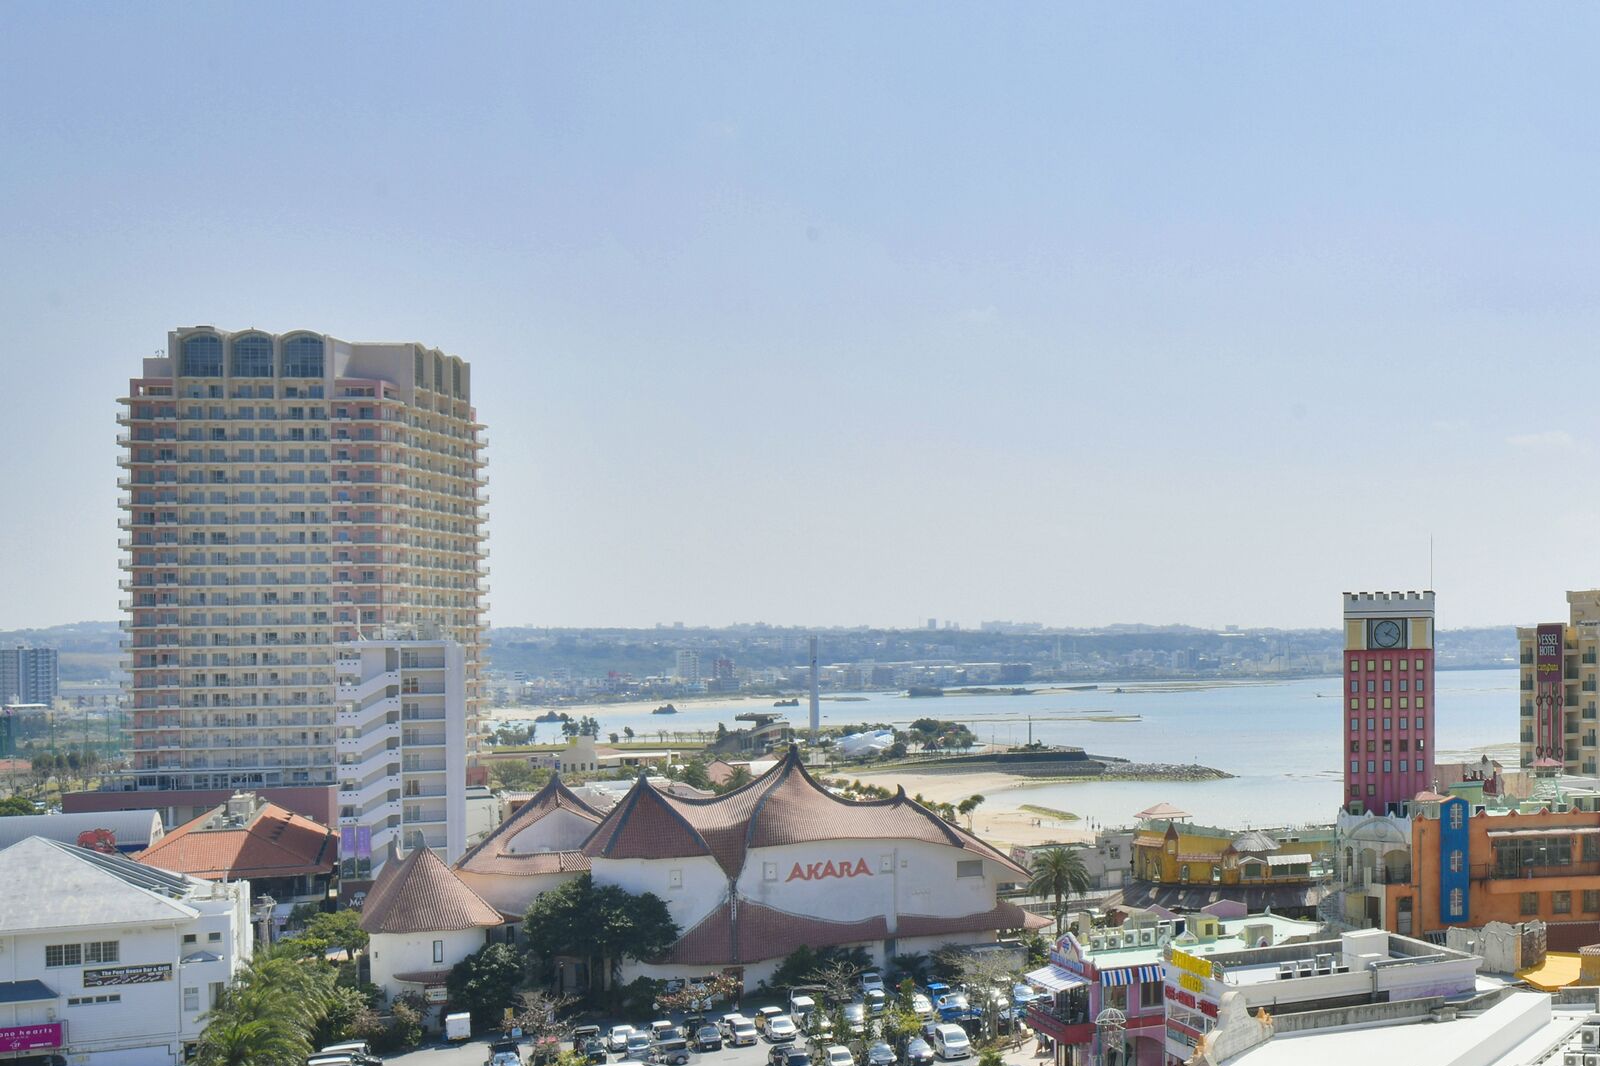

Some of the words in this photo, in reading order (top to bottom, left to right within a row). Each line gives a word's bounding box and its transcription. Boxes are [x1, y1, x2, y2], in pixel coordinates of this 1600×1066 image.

[1538, 634, 1558, 645] VESSEL
[1539, 645, 1556, 656] HOTEL
[785, 857, 874, 882] AKARA
[19, 1027, 53, 1036] hearts
